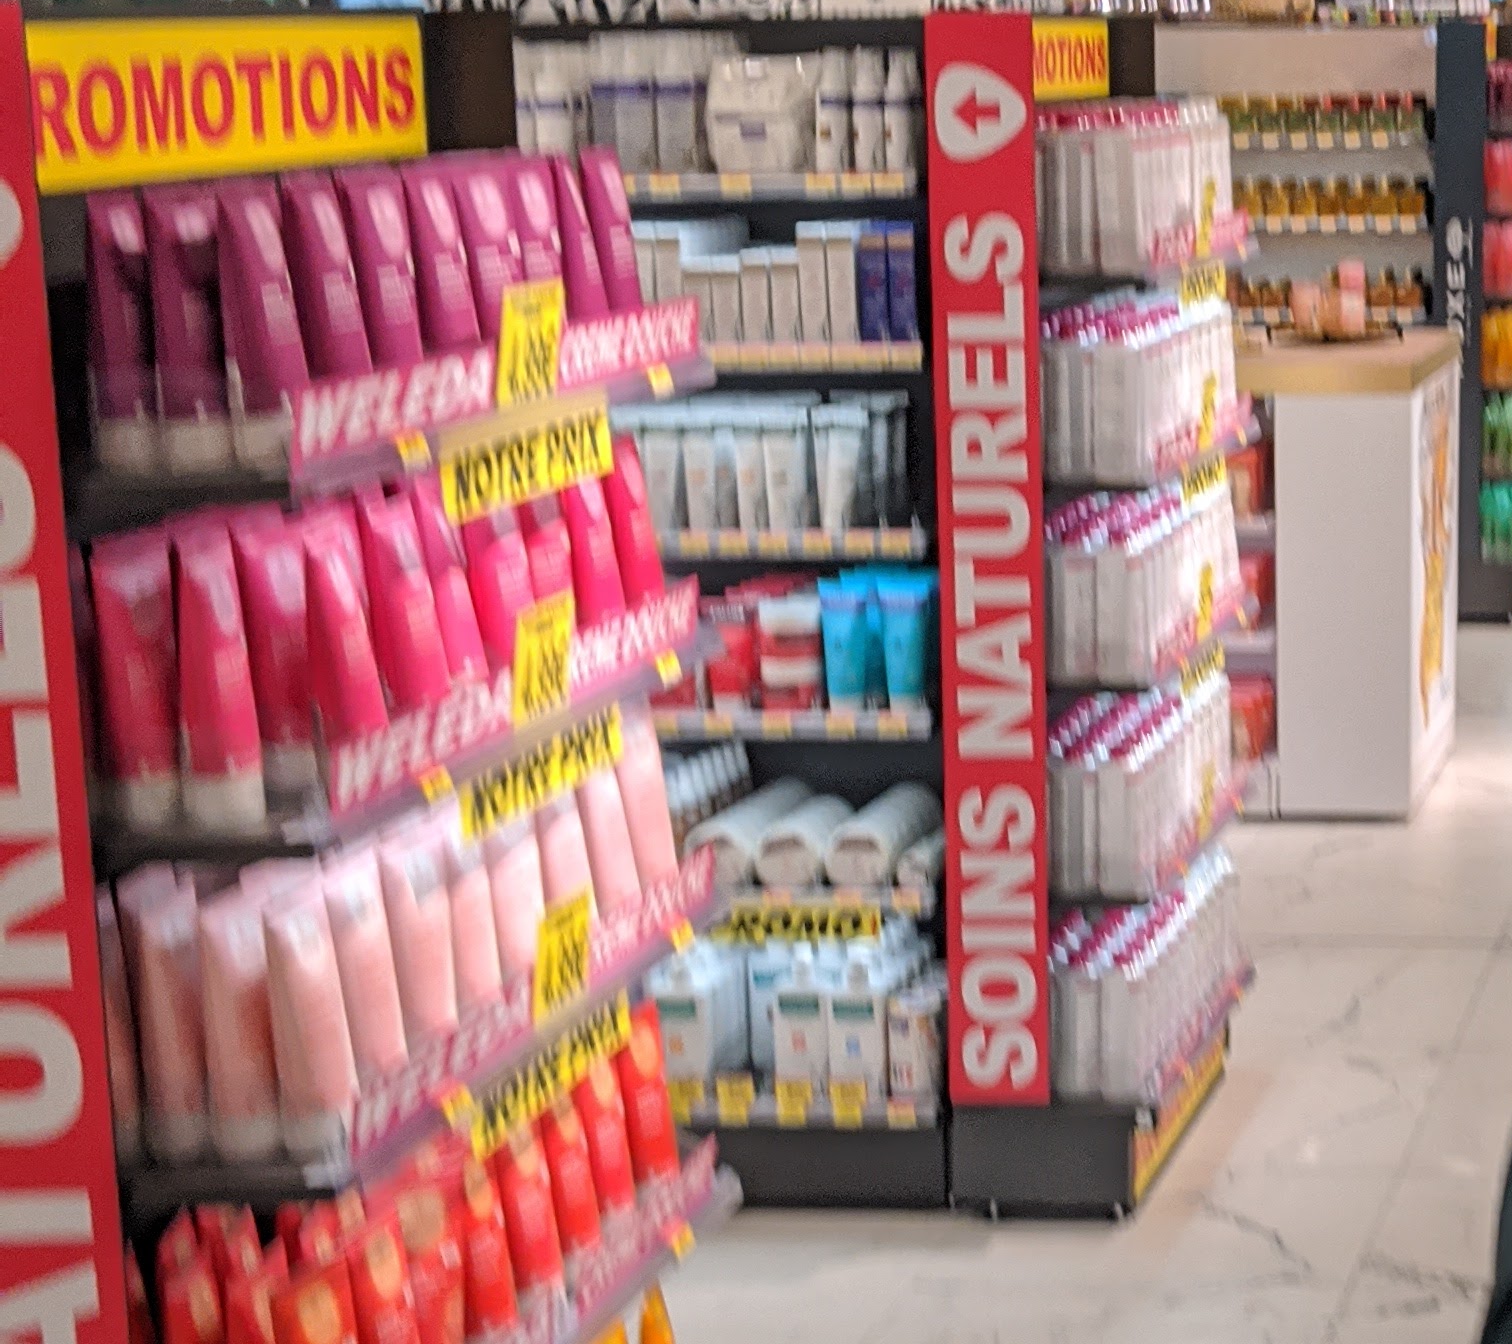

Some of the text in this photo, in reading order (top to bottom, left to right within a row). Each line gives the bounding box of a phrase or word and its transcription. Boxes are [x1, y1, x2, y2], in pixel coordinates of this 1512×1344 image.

[32, 47, 415, 164] ROMOTIONS
[1033, 35, 1105, 85] MOTIONS
[943, 212, 1040, 1090] SOINS NATURELS
